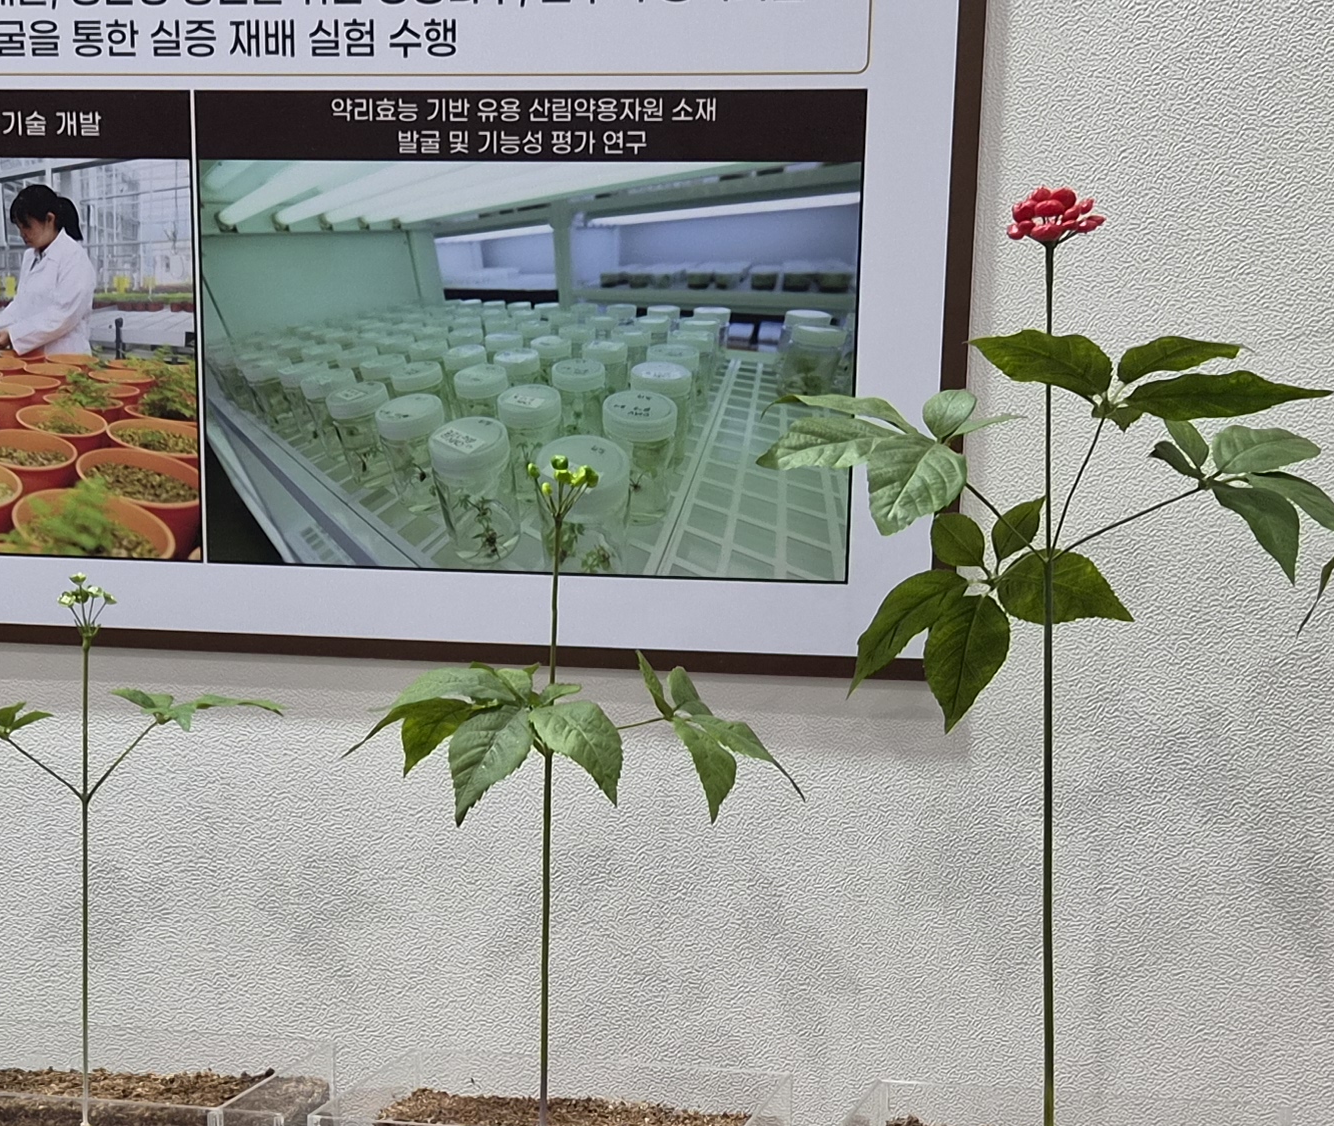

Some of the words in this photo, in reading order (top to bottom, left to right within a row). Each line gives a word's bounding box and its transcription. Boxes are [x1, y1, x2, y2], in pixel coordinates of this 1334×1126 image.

[72, 19, 139, 58] 통한
[150, 19, 217, 58] 실증
[229, 19, 295, 58] 재배
[309, 19, 375, 58] 실험
[388, 19, 458, 58] 수행
[1, 110, 47, 137] 기술
[55, 110, 102, 137] 개발
[331, 98, 418, 122] 약리효능
[426, 98, 469, 122] 기반
[477, 98, 520, 122] 유용
[528, 98, 663, 122] 산림약용자원
[671, 98, 717, 123] 소재
[397, 130, 441, 154] 발굴
[448, 130, 468, 154] 및
[477, 130, 543, 155] 기능성
[551, 130, 595, 155] 평가
[602, 131, 648, 155] 연구
